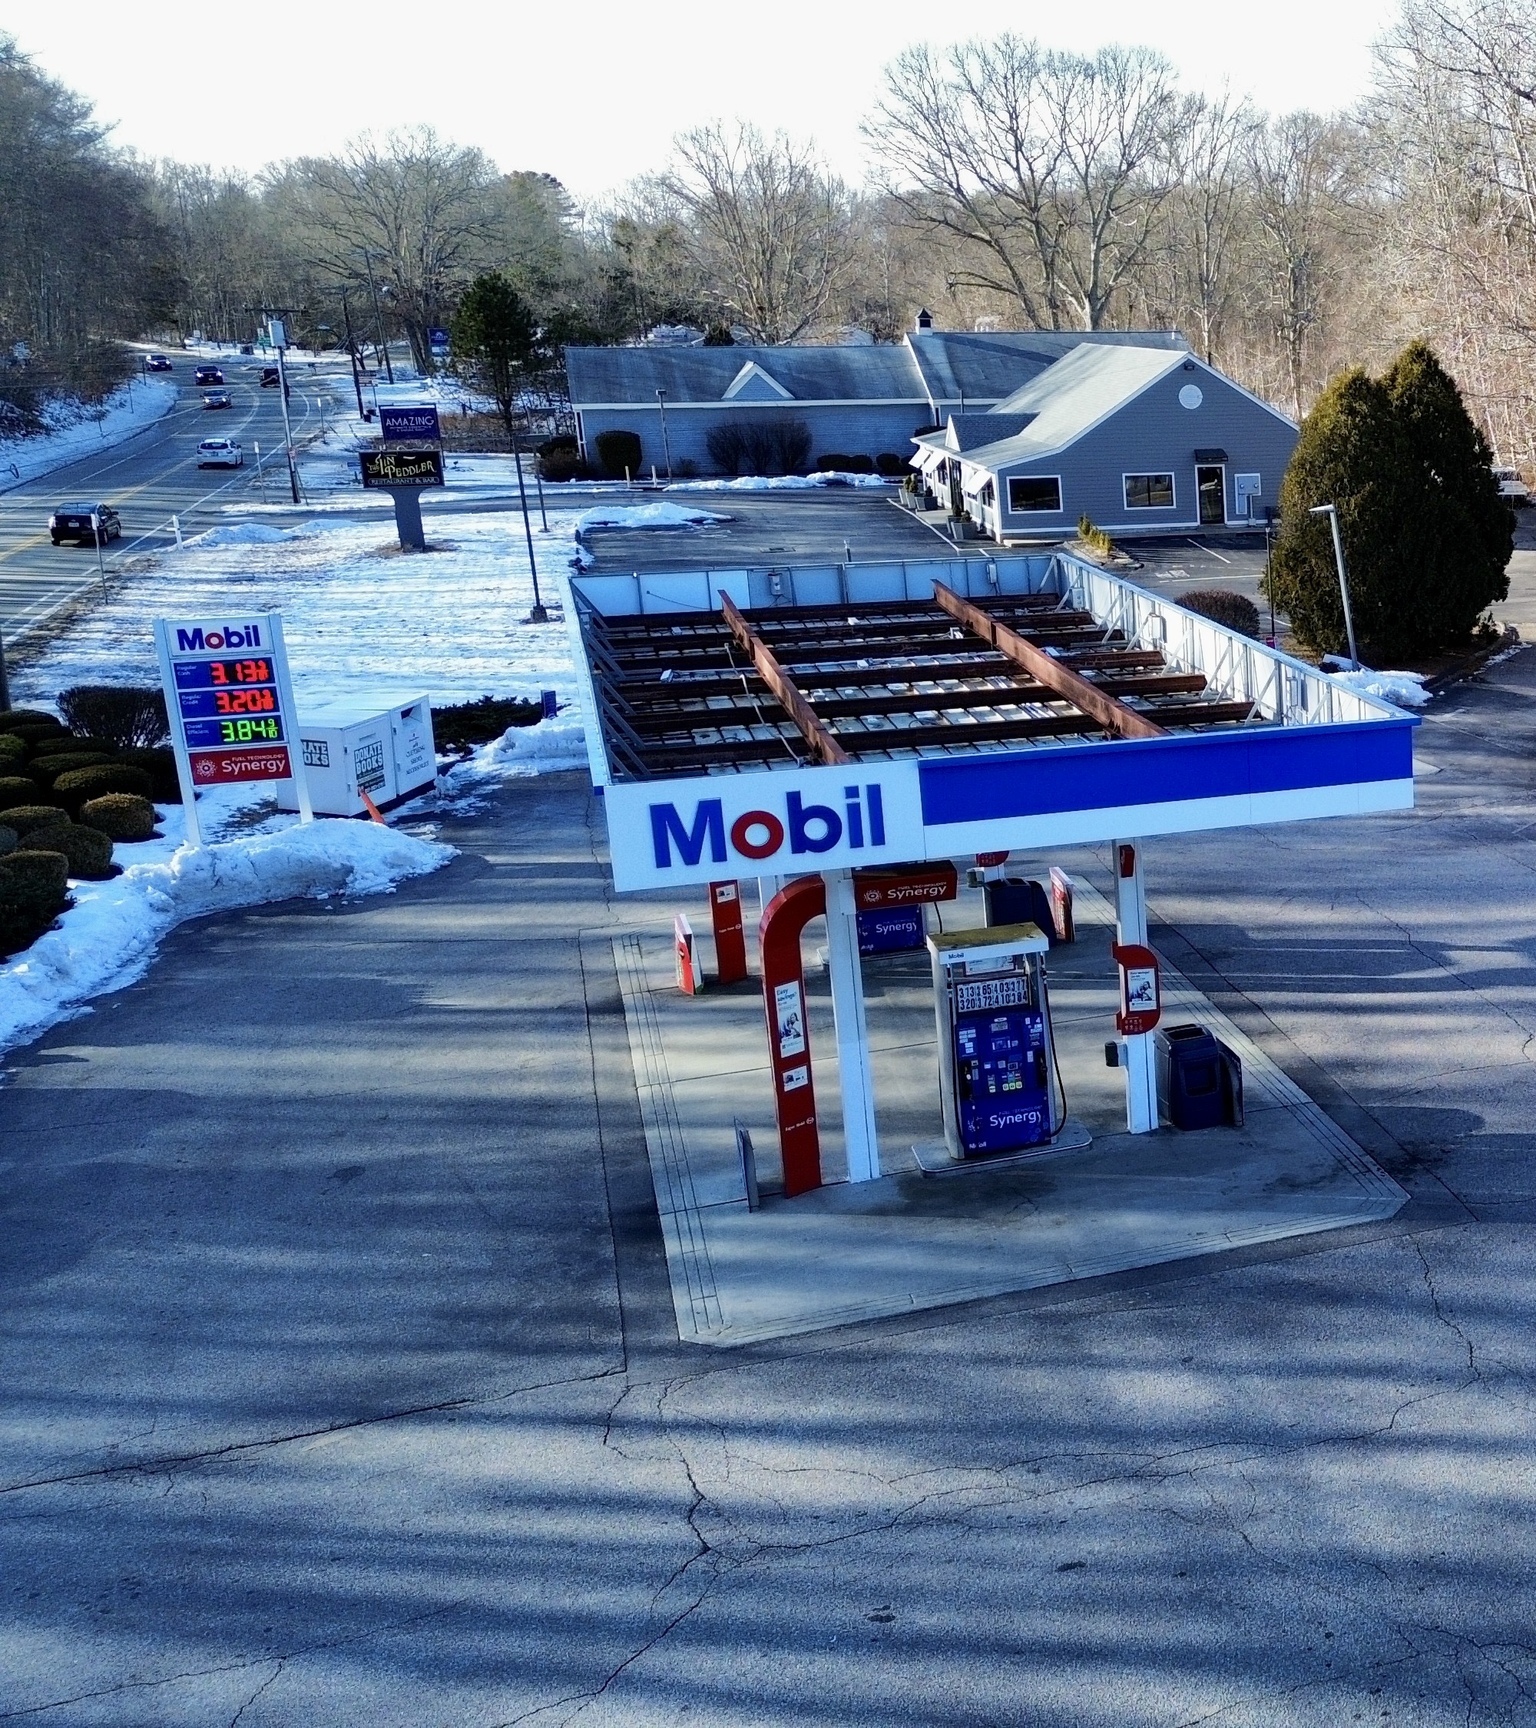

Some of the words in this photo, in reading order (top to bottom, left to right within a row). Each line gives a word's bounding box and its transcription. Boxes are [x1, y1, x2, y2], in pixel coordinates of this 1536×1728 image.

[386, 416, 434, 426] AMAZING
[384, 460, 436, 478] PEDDLER
[176, 625, 261, 651] Mobil
[355, 742, 382, 762] DONATE
[222, 760, 286, 775] Synergy
[356, 754, 383, 774] BOOKS
[649, 783, 886, 869] Mobil
[887, 886, 947, 900] Synergy
[876, 922, 916, 935] Synergy
[990, 1111, 1041, 1128] Synergy
